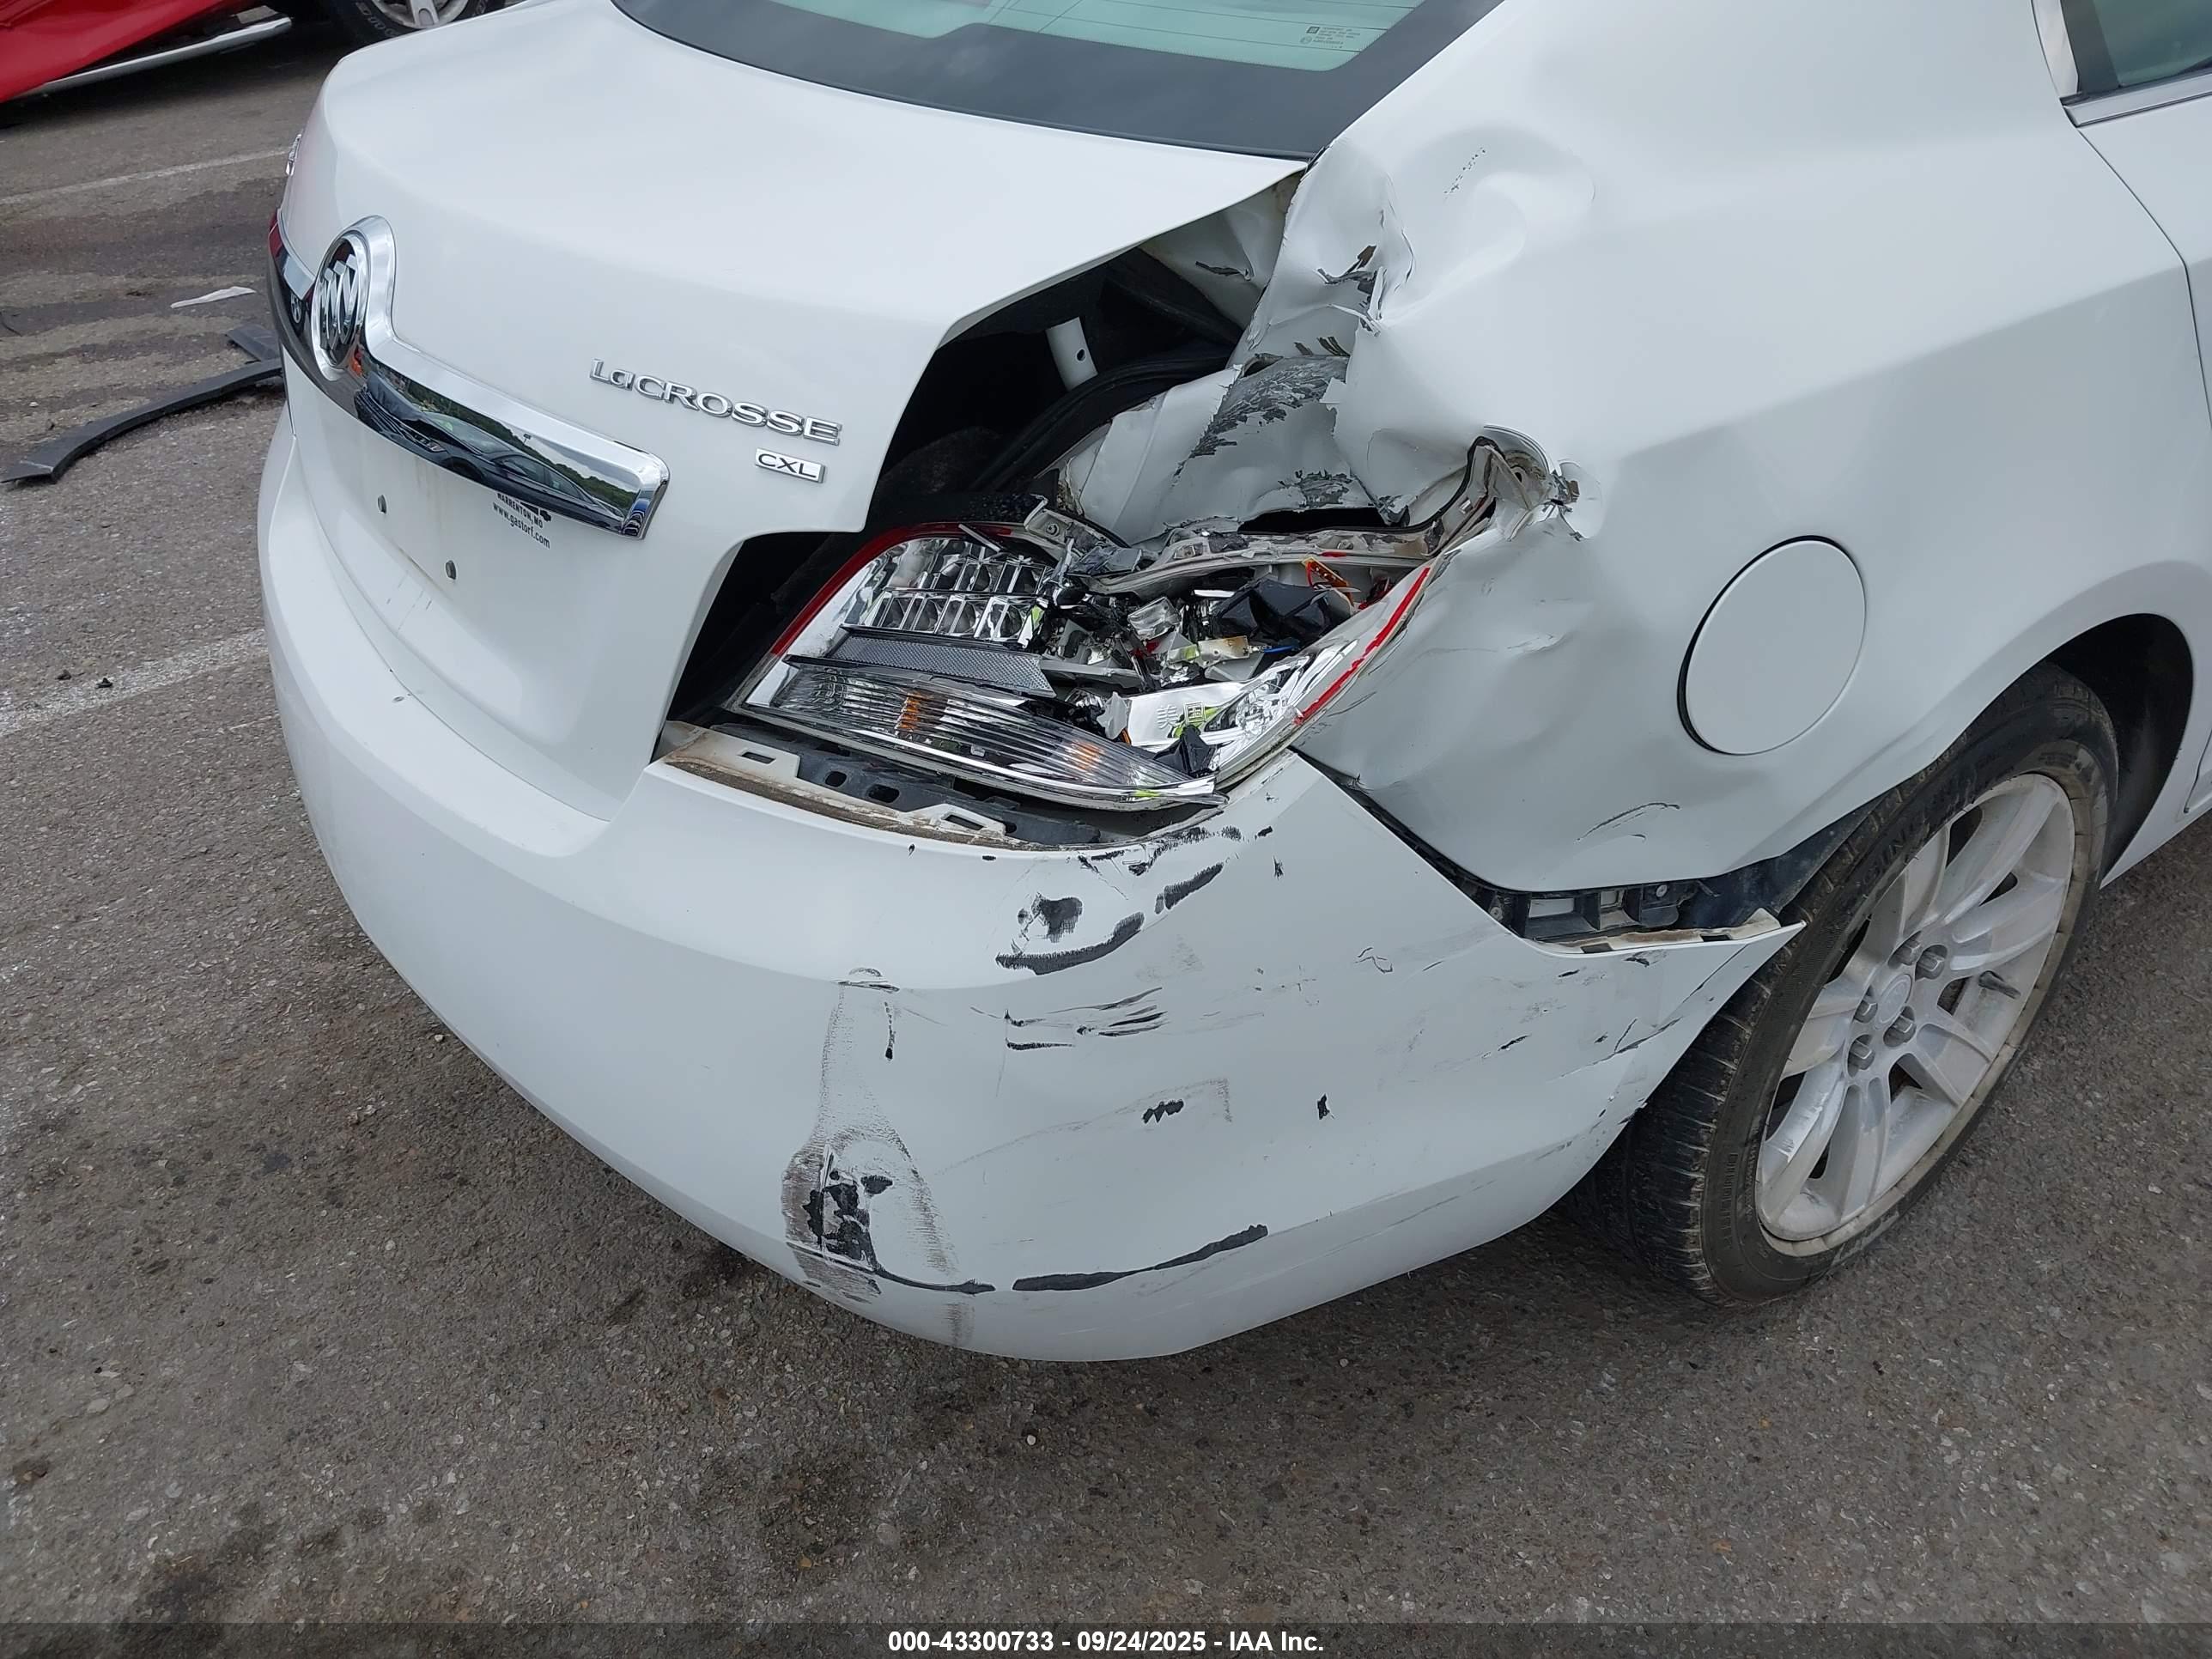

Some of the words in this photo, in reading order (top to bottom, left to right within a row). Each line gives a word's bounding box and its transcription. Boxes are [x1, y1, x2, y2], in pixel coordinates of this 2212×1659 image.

[757, 453, 817, 478] CXL
[492, 502, 550, 550] www.gastorf.com
[533, 515, 544, 529] MO
